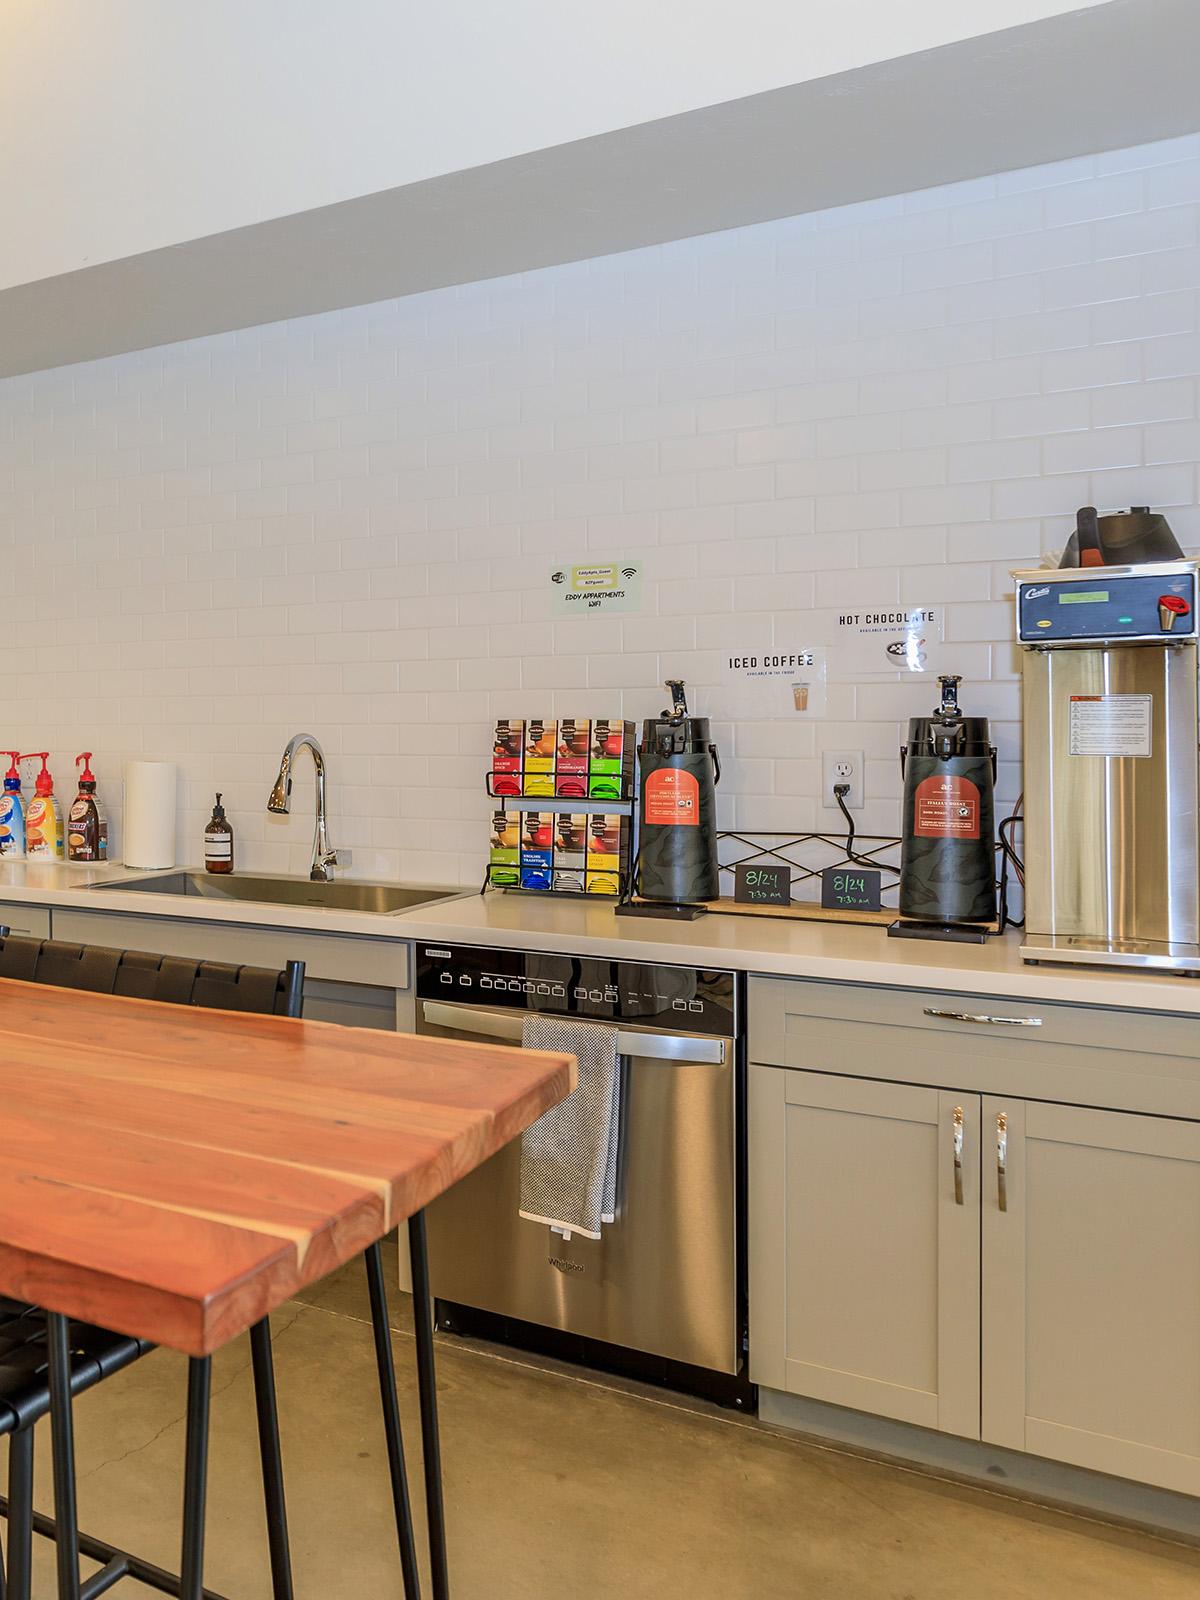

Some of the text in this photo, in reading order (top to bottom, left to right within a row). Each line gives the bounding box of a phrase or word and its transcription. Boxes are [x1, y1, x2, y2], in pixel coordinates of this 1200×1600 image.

[839, 615, 860, 625] HOT
[729, 655, 813, 668] ICED COFFEE
[745, 870, 778, 888] 8/24
[833, 875, 864, 893] 8/24
[748, 890, 767, 898] 7:30
[547, 1256, 584, 1272] Whirlpool
